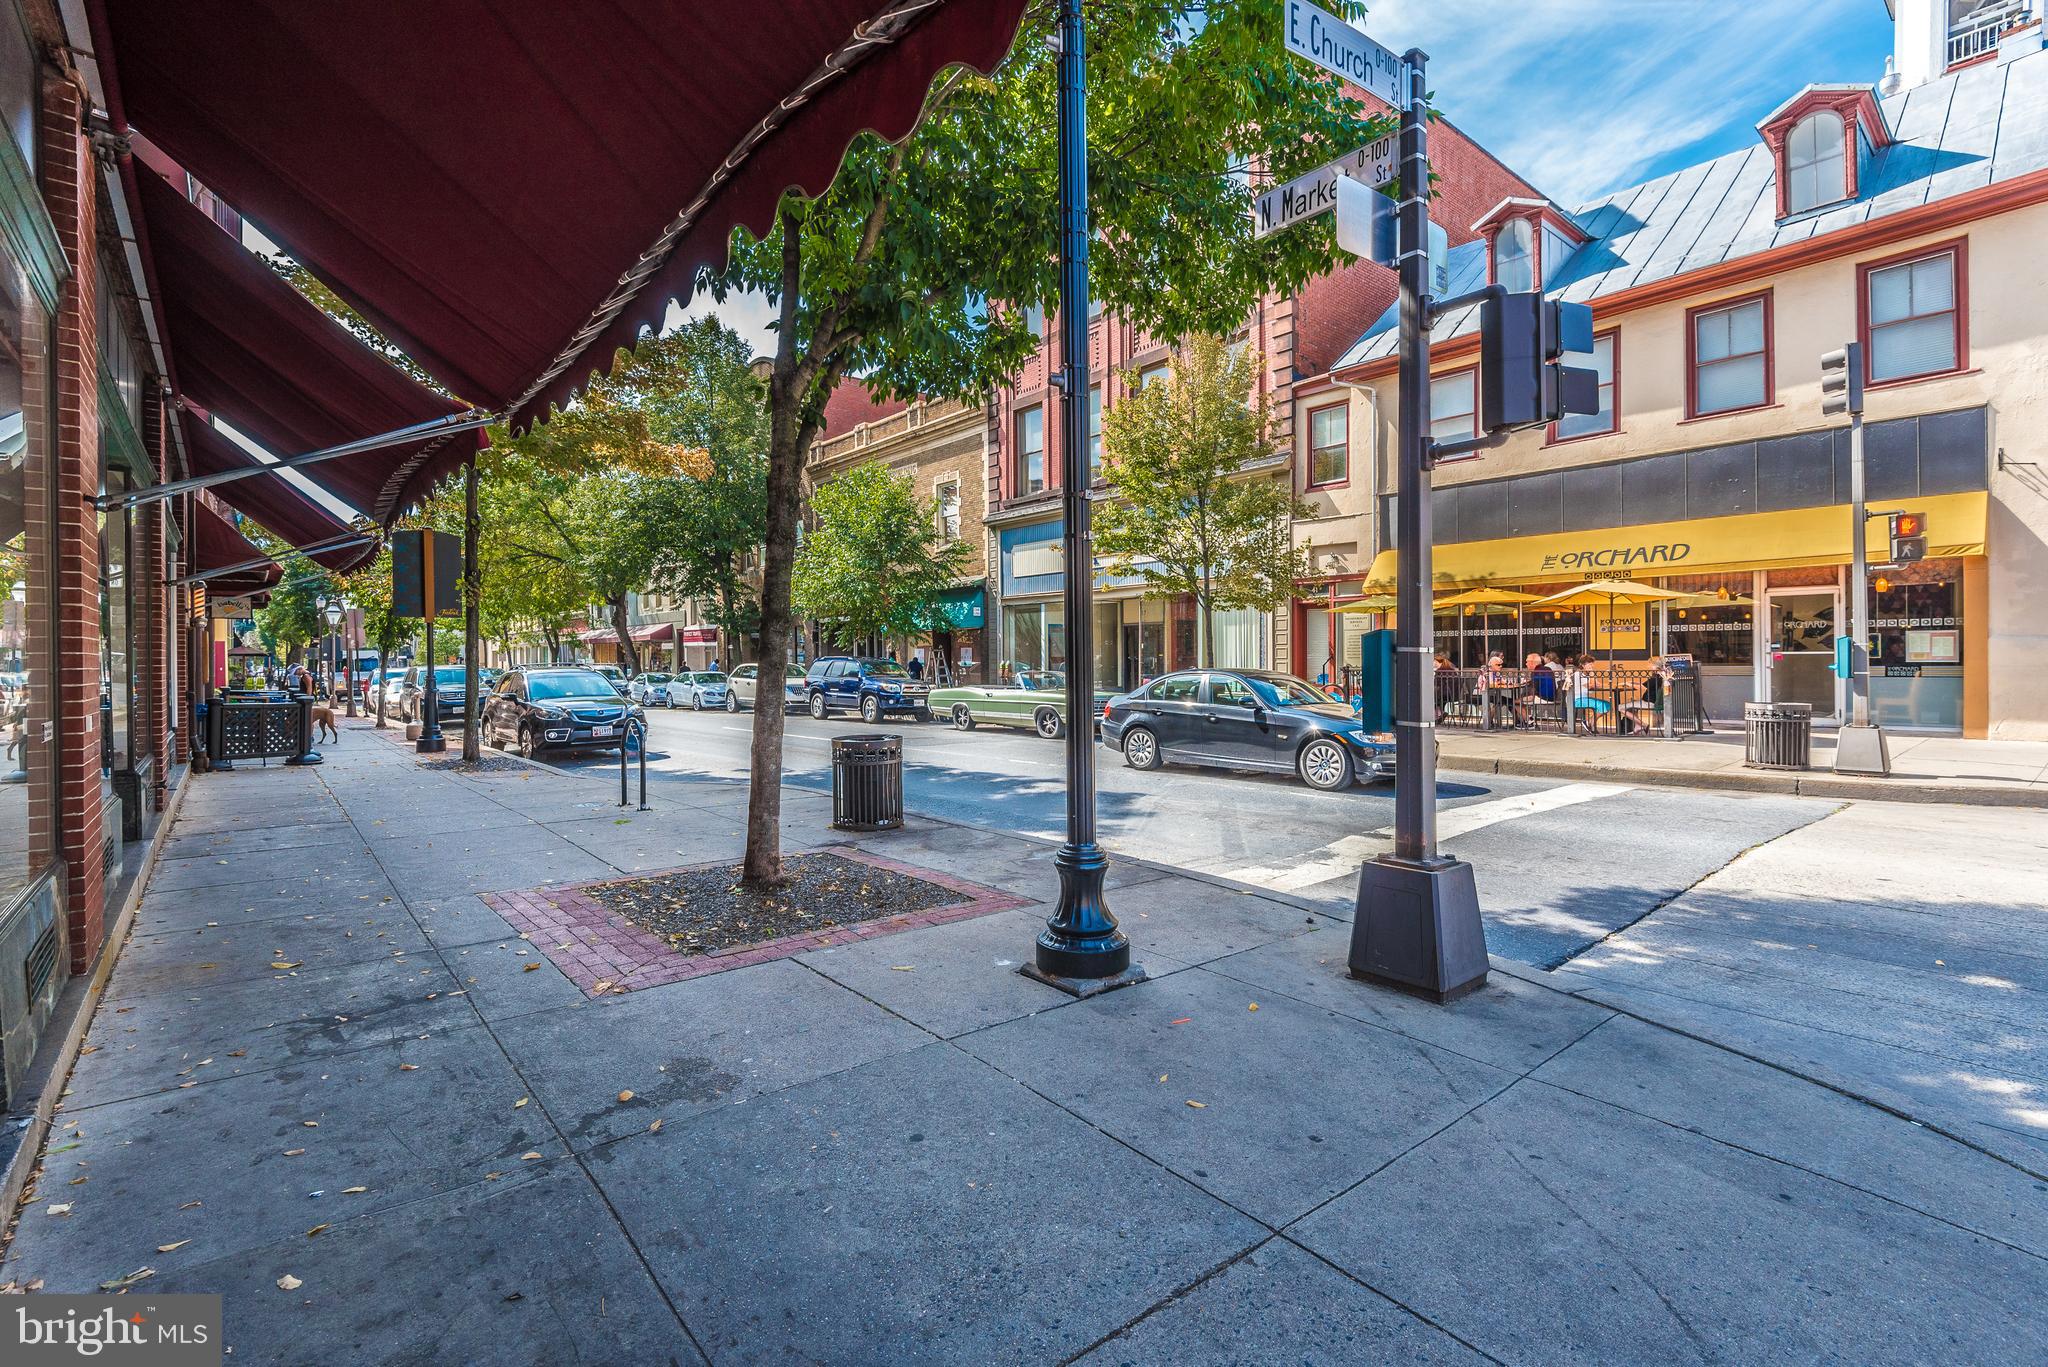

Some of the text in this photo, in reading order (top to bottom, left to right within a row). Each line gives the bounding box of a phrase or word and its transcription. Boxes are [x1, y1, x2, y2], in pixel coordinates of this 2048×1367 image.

[1291, 2, 1399, 104] E. Church St
[1375, 49, 1398, 78] 0-100
[1358, 138, 1390, 168] 0-100
[1261, 197, 1277, 231] N.
[1376, 164, 1387, 183] St
[1541, 543, 1690, 571] THE ORCHARD
[1784, 620, 1827, 628] ORCHARD
